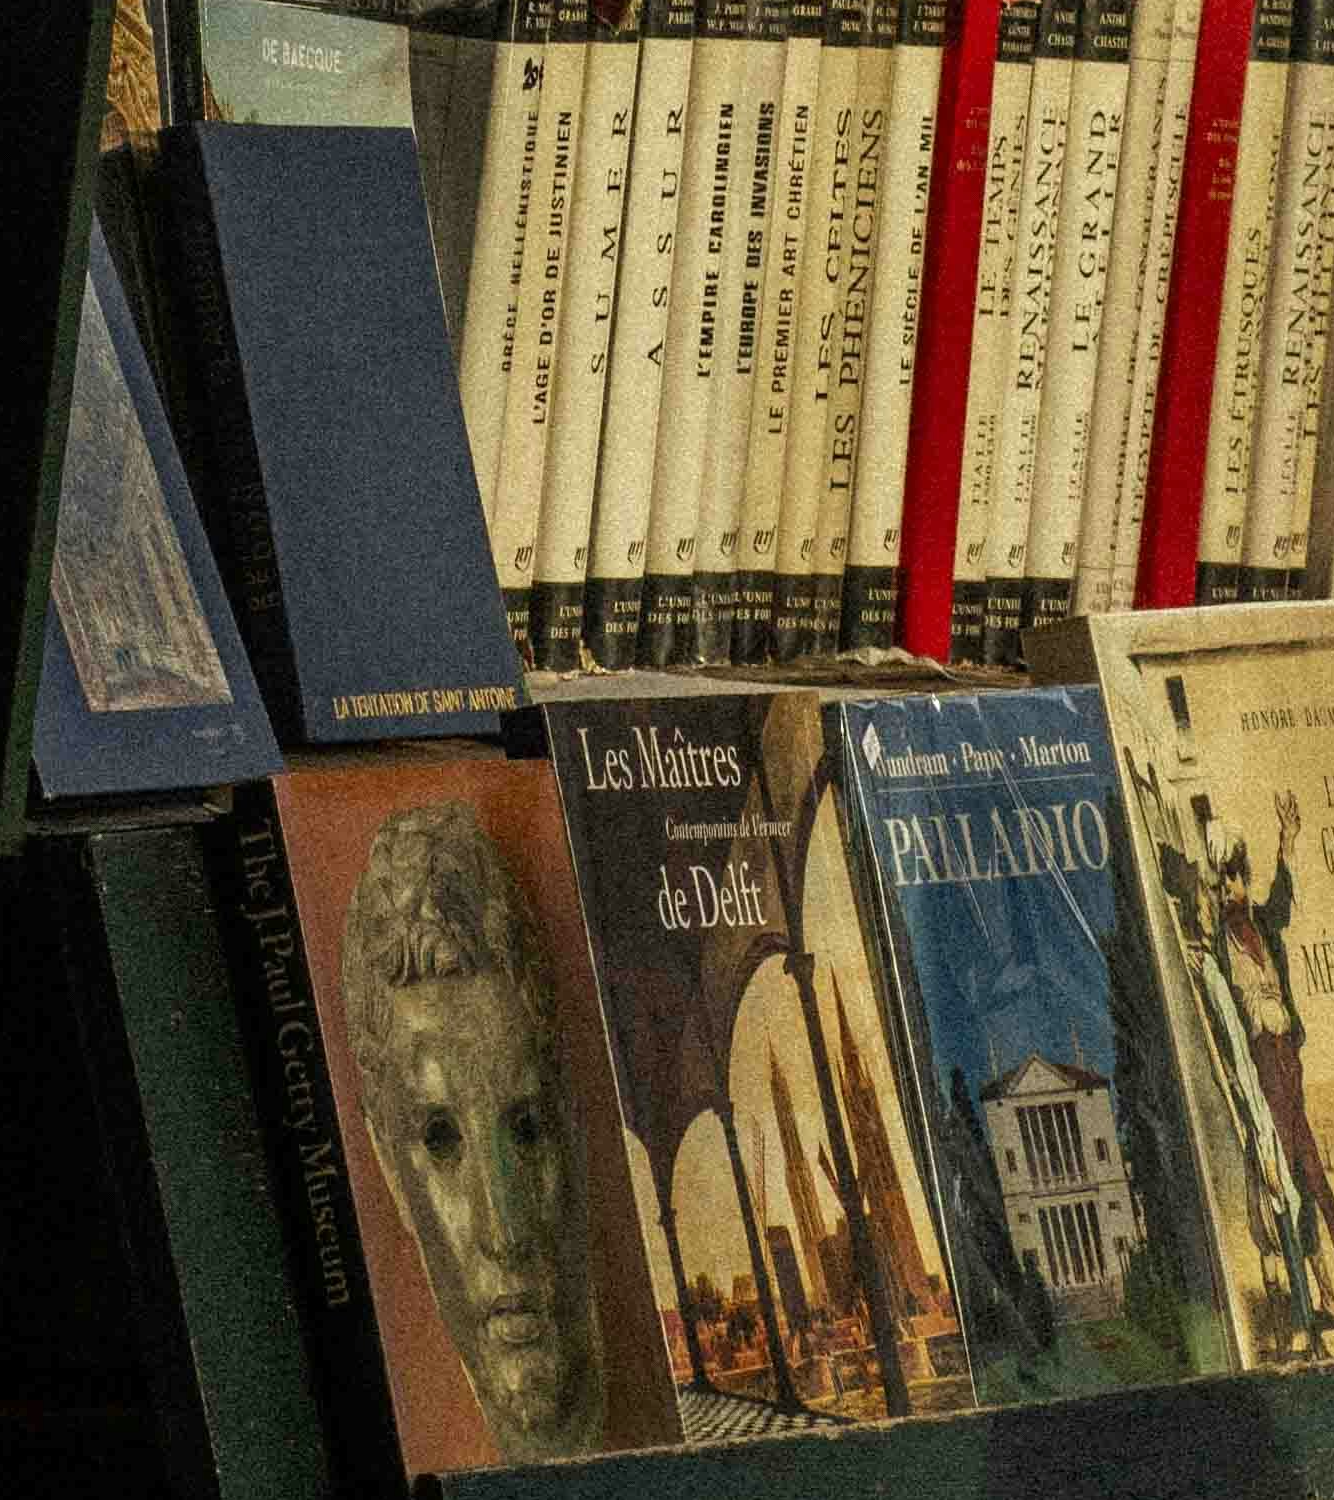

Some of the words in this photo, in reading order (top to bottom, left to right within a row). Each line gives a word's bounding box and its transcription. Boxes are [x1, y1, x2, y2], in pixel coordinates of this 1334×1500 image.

[261, 38, 279, 65] DE
[282, 41, 343, 75] BAECQUE
[548, 110, 573, 238] JUSTINIEN
[750, 101, 775, 218] INVASIONS
[786, 104, 810, 221] CHRÉTIEN
[919, 113, 934, 153] MIL
[708, 103, 734, 255] CAROLINGIEN
[825, 107, 853, 284] CELTES
[914, 164, 930, 215] L'AN
[983, 135, 1008, 248] TEMPS
[1077, 109, 1108, 280] GRAND
[544, 247, 560, 279] DE
[590, 107, 629, 375] SUMER
[646, 104, 684, 367] ASSUR
[746, 229, 764, 269] DES
[781, 234, 800, 277] ART
[838, 107, 884, 388] PHÉNICIENS
[910, 228, 924, 255] DE
[1016, 109, 1058, 390] RENAISSANCE
[1281, 118, 1326, 386] RENAISSANCE
[538, 291, 557, 347] D'OR
[697, 270, 720, 378] L'EMPIRE
[736, 279, 760, 375] L'EUROPE
[902, 266, 923, 346] SIÈCLE
[978, 271, 997, 317] LE
[1071, 302, 1093, 353] LE
[771, 287, 795, 393] PREMIER
[815, 310, 836, 402] LES
[899, 357, 914, 386] LE
[532, 354, 551, 425] L'AGE
[768, 406, 785, 435] LE
[829, 412, 856, 492] LES
[972, 415, 988, 504] ITALIE
[1224, 433, 1244, 496] LES
[332, 695, 349, 720] LA
[351, 689, 414, 719] TENTATION
[414, 690, 429, 715] DE
[432, 687, 466, 713] SAINT
[467, 686, 517, 713] ANTOINE
[577, 726, 634, 790] Les
[631, 725, 742, 790] Maîtres
[1018, 735, 1092, 768] Marton
[239, 817, 278, 902] The
[665, 816, 739, 847] Contemporains
[738, 816, 751, 838] de
[750, 812, 794, 838] Vermeer
[883, 800, 1110, 888] PALLADIO
[658, 862, 692, 930] de
[688, 861, 768, 929] Delft
[259, 931, 306, 1013] Paul
[276, 1014, 317, 1134] Getty
[298, 1137, 352, 1309] Museum
